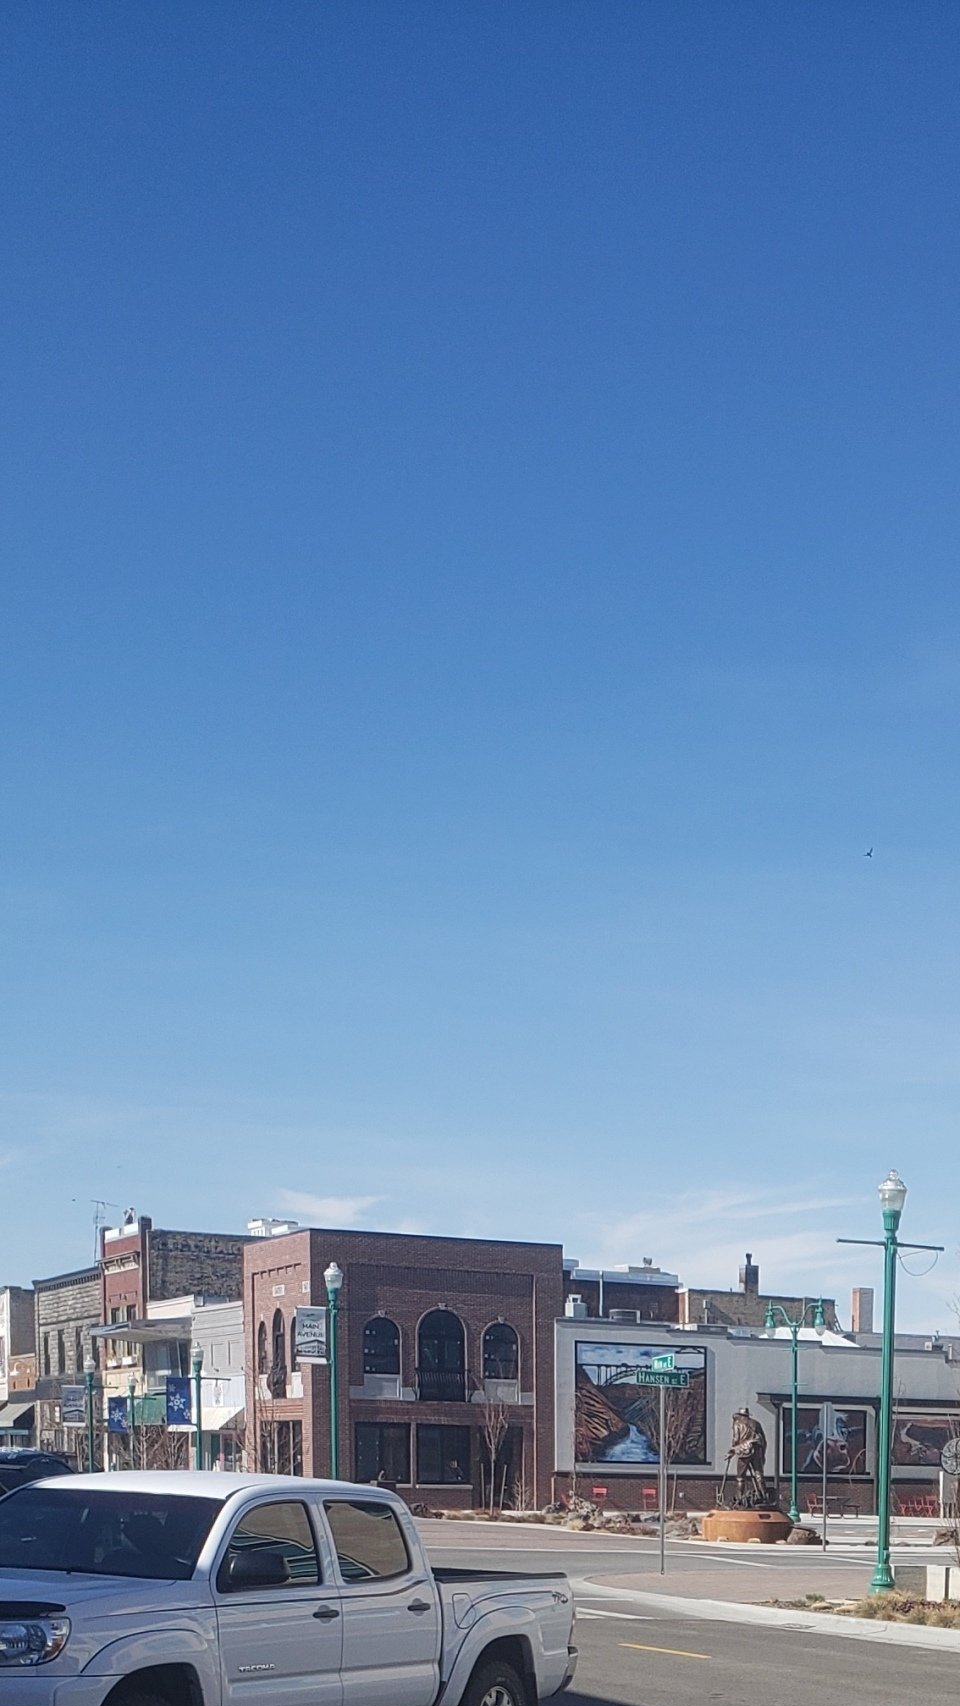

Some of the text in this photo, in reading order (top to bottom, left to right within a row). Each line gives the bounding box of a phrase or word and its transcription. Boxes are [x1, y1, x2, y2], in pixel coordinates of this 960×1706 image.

[638, 1372, 670, 1384] HANSEN
[680, 1374, 686, 1385] E
[238, 1663, 276, 1673] TACOMA
